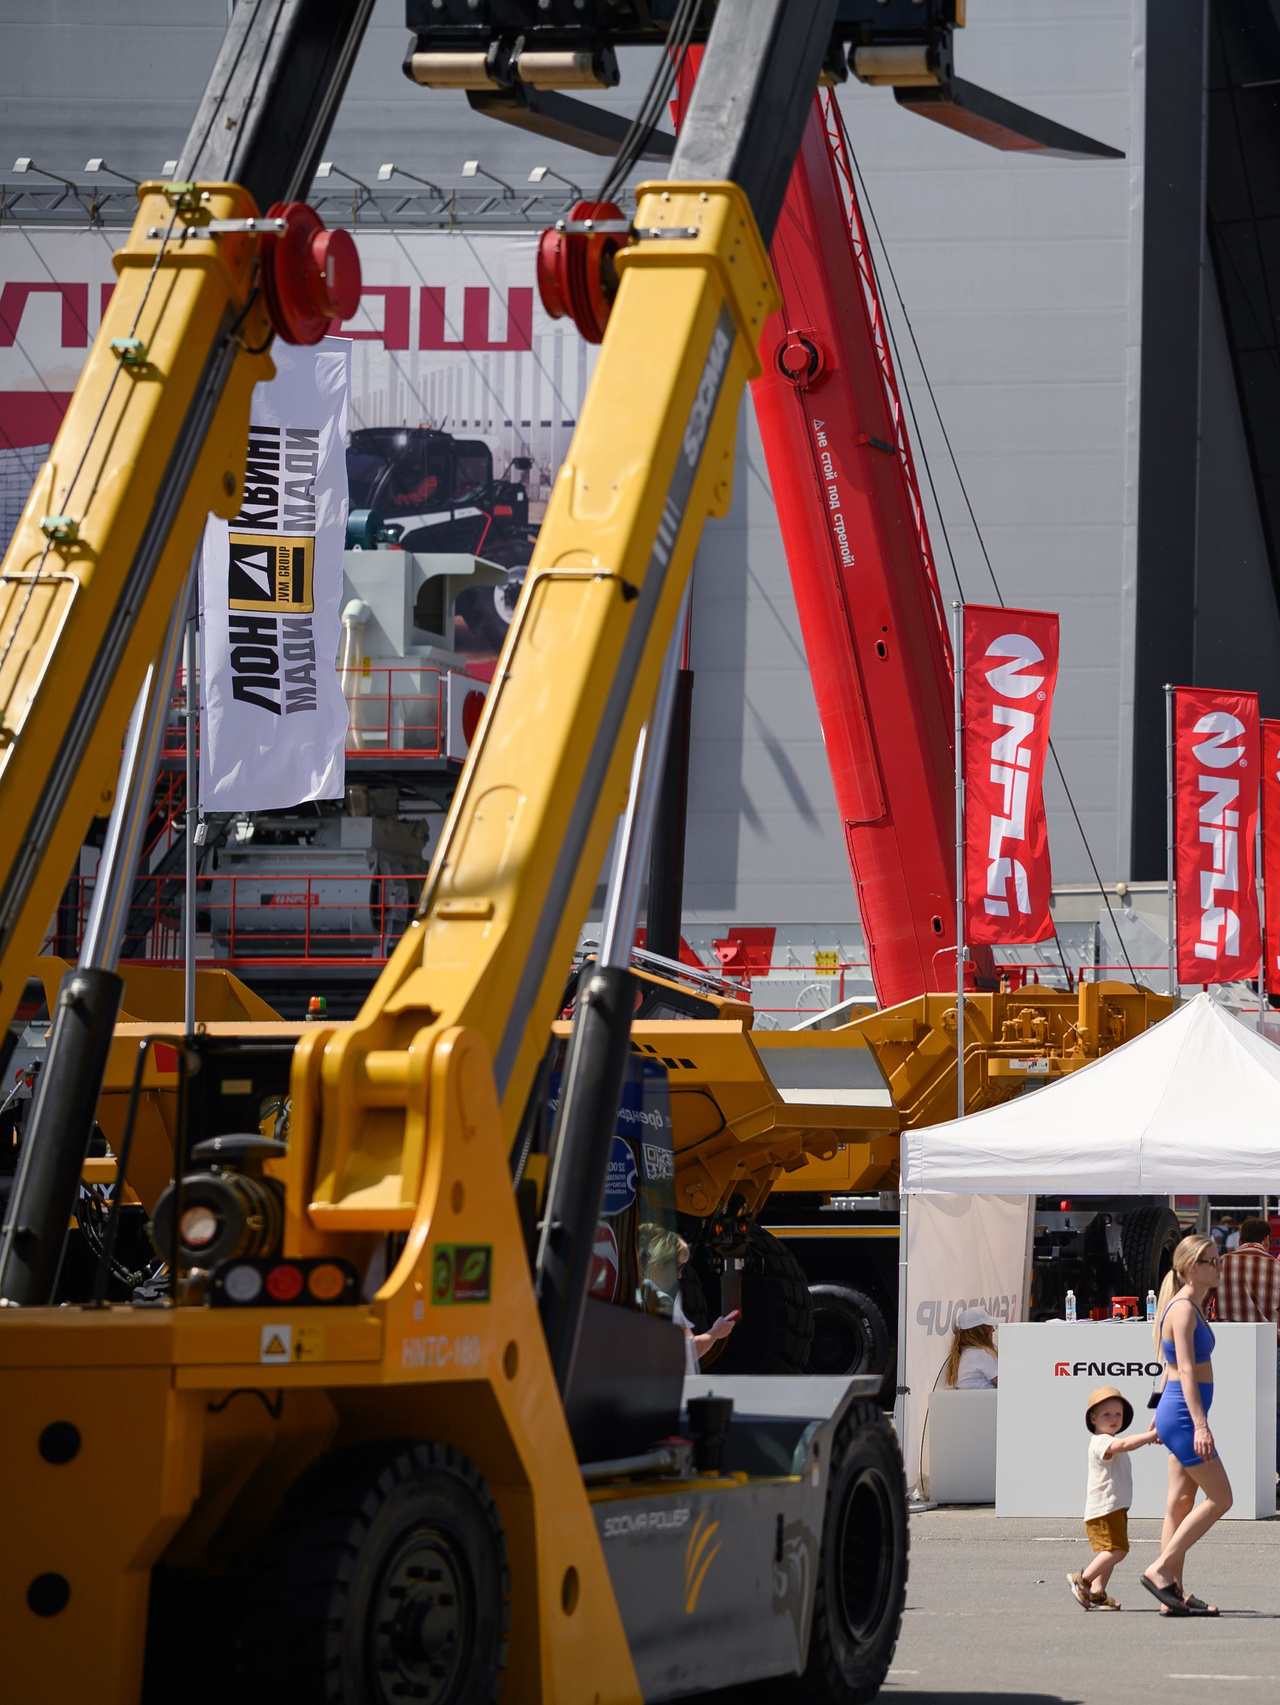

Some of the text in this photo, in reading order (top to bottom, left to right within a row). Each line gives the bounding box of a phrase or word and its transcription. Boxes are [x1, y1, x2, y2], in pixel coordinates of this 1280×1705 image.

[283, 427, 319, 531] МАДИ
[817, 431, 855, 567] не стой под стрелой!
[278, 546, 291, 603] JVM GROUP
[229, 615, 282, 716] ЛОН
[282, 617, 317, 715] МАДИ
[1072, 1361, 1167, 1377] FNGRO
